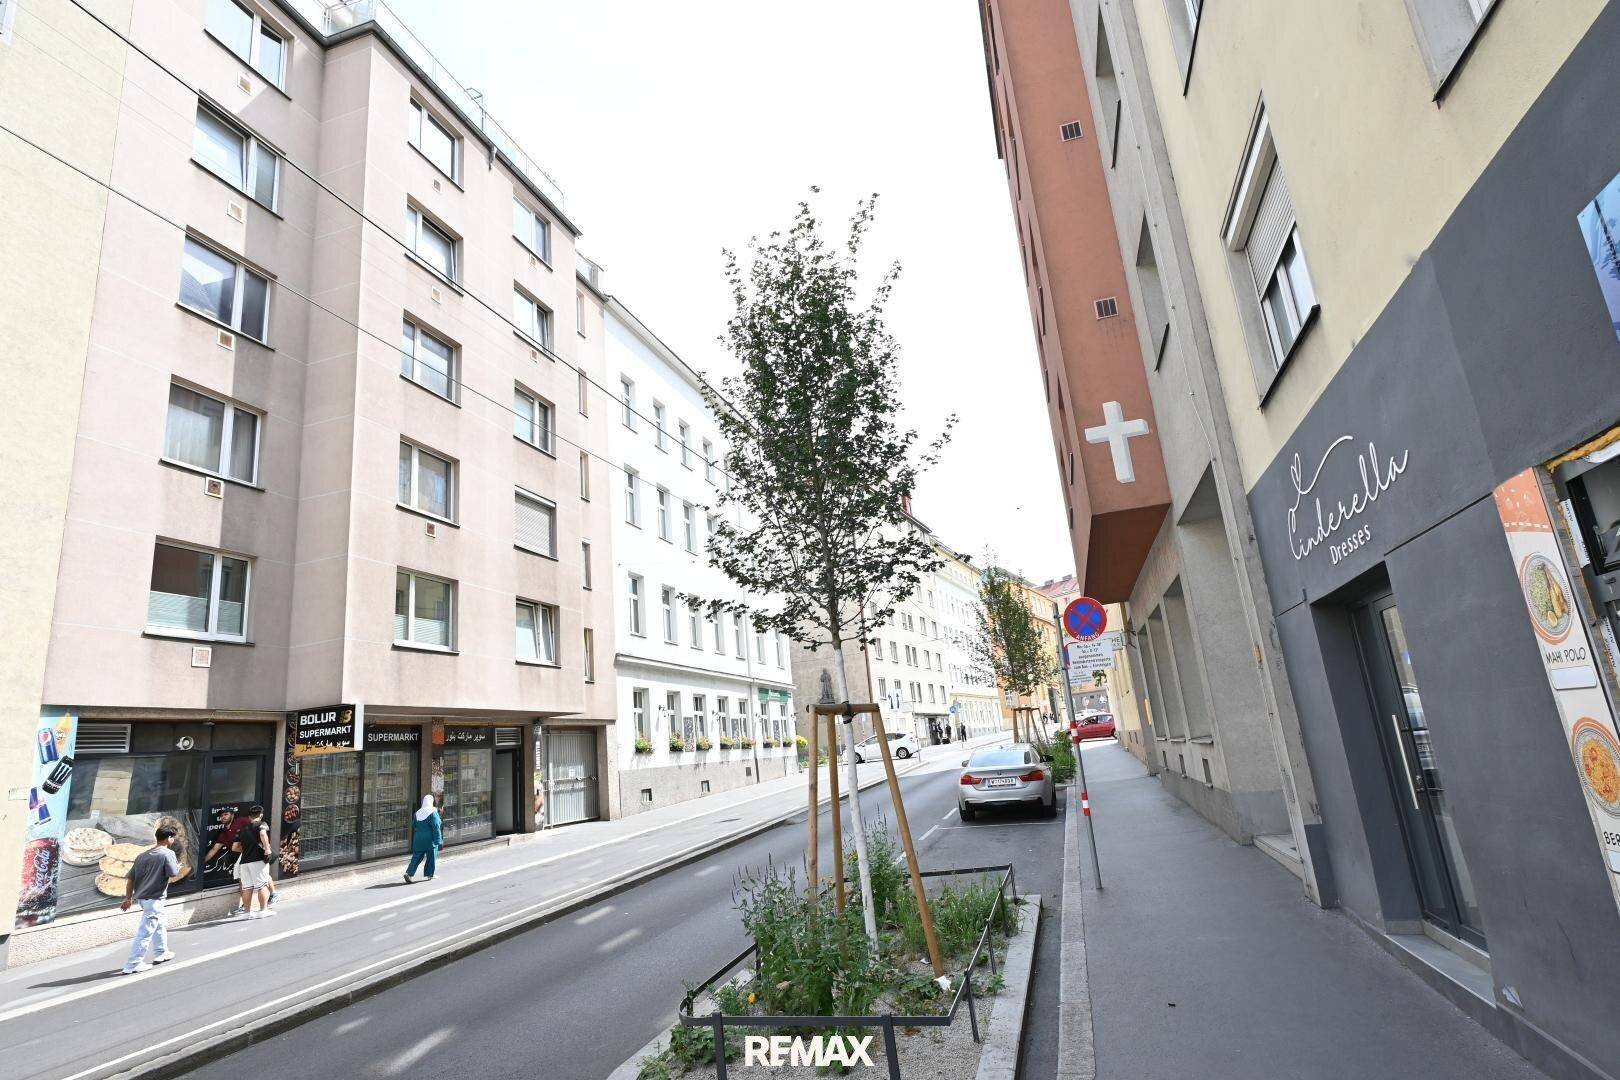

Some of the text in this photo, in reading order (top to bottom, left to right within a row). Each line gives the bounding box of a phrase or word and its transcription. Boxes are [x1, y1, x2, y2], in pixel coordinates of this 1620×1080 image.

[1287, 435, 1408, 560] Cinderella
[1329, 524, 1372, 565] Dresses
[1076, 632, 1100, 641] ANFANG
[1545, 648, 1564, 664] MAHI
[1564, 646, 1587, 662] POLO
[300, 711, 337, 726] BOLUR
[299, 725, 353, 739] SUPERMARKT
[367, 732, 419, 742] SUPERMARKT
